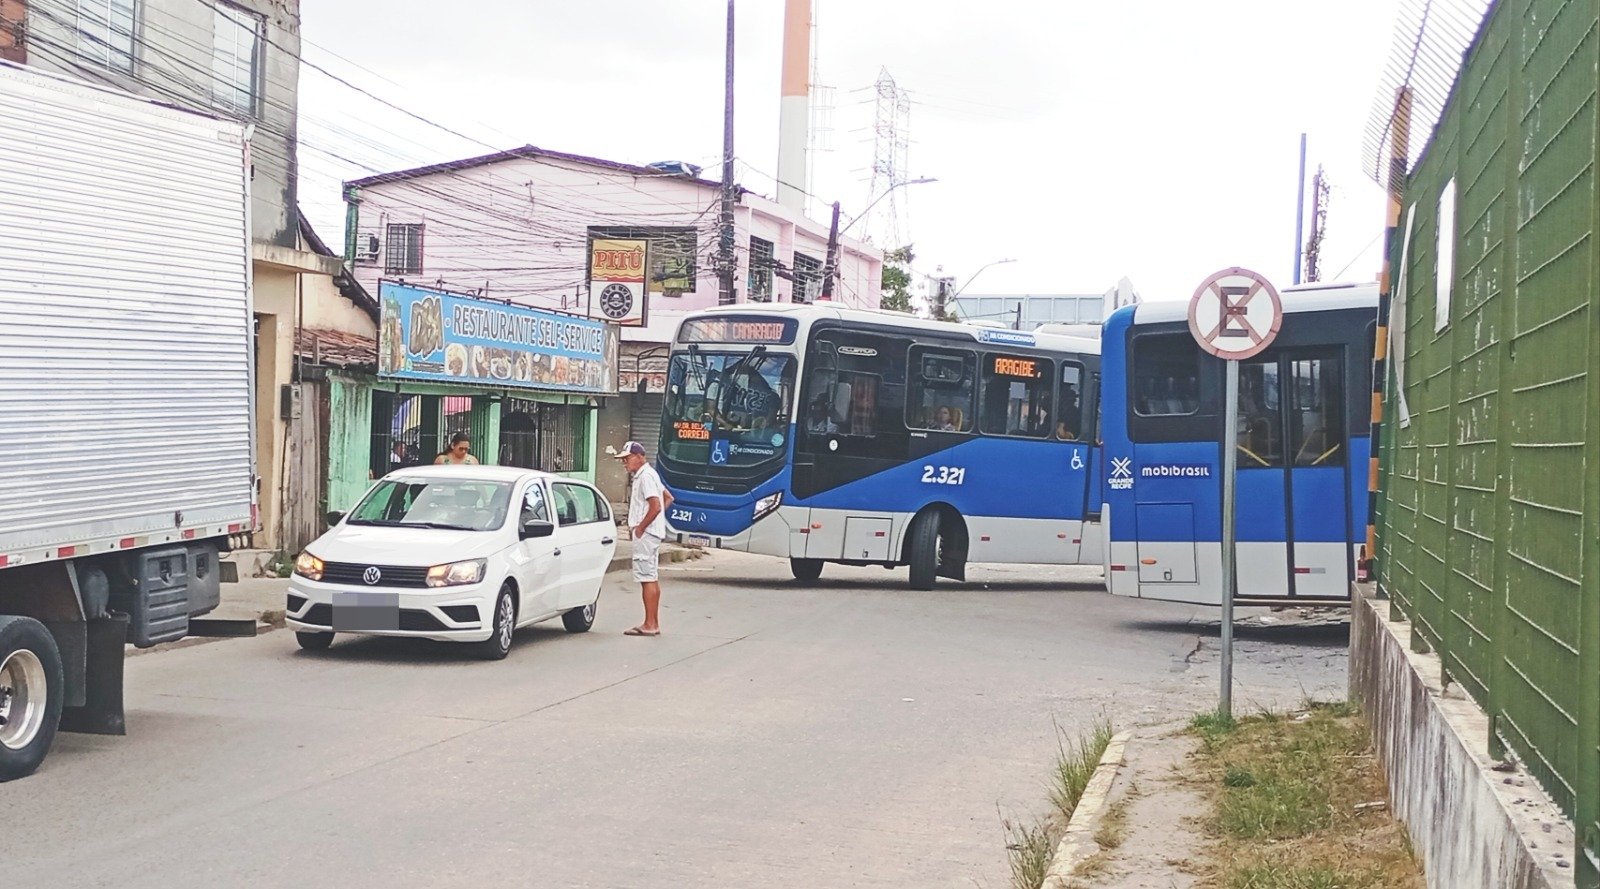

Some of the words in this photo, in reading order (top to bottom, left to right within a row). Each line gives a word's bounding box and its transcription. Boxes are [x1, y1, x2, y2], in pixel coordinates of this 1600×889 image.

[1219, 286, 1250, 338] E
[452, 304, 536, 345] RESTAURANTE
[538, 319, 602, 354] SELF-SERVICE
[997, 333, 1035, 344] CONDICIONADO
[678, 429, 710, 440] CORREIA
[921, 465, 965, 485] 2.321
[1142, 465, 1210, 476] mobibrasil
[671, 509, 692, 522] 2.321
